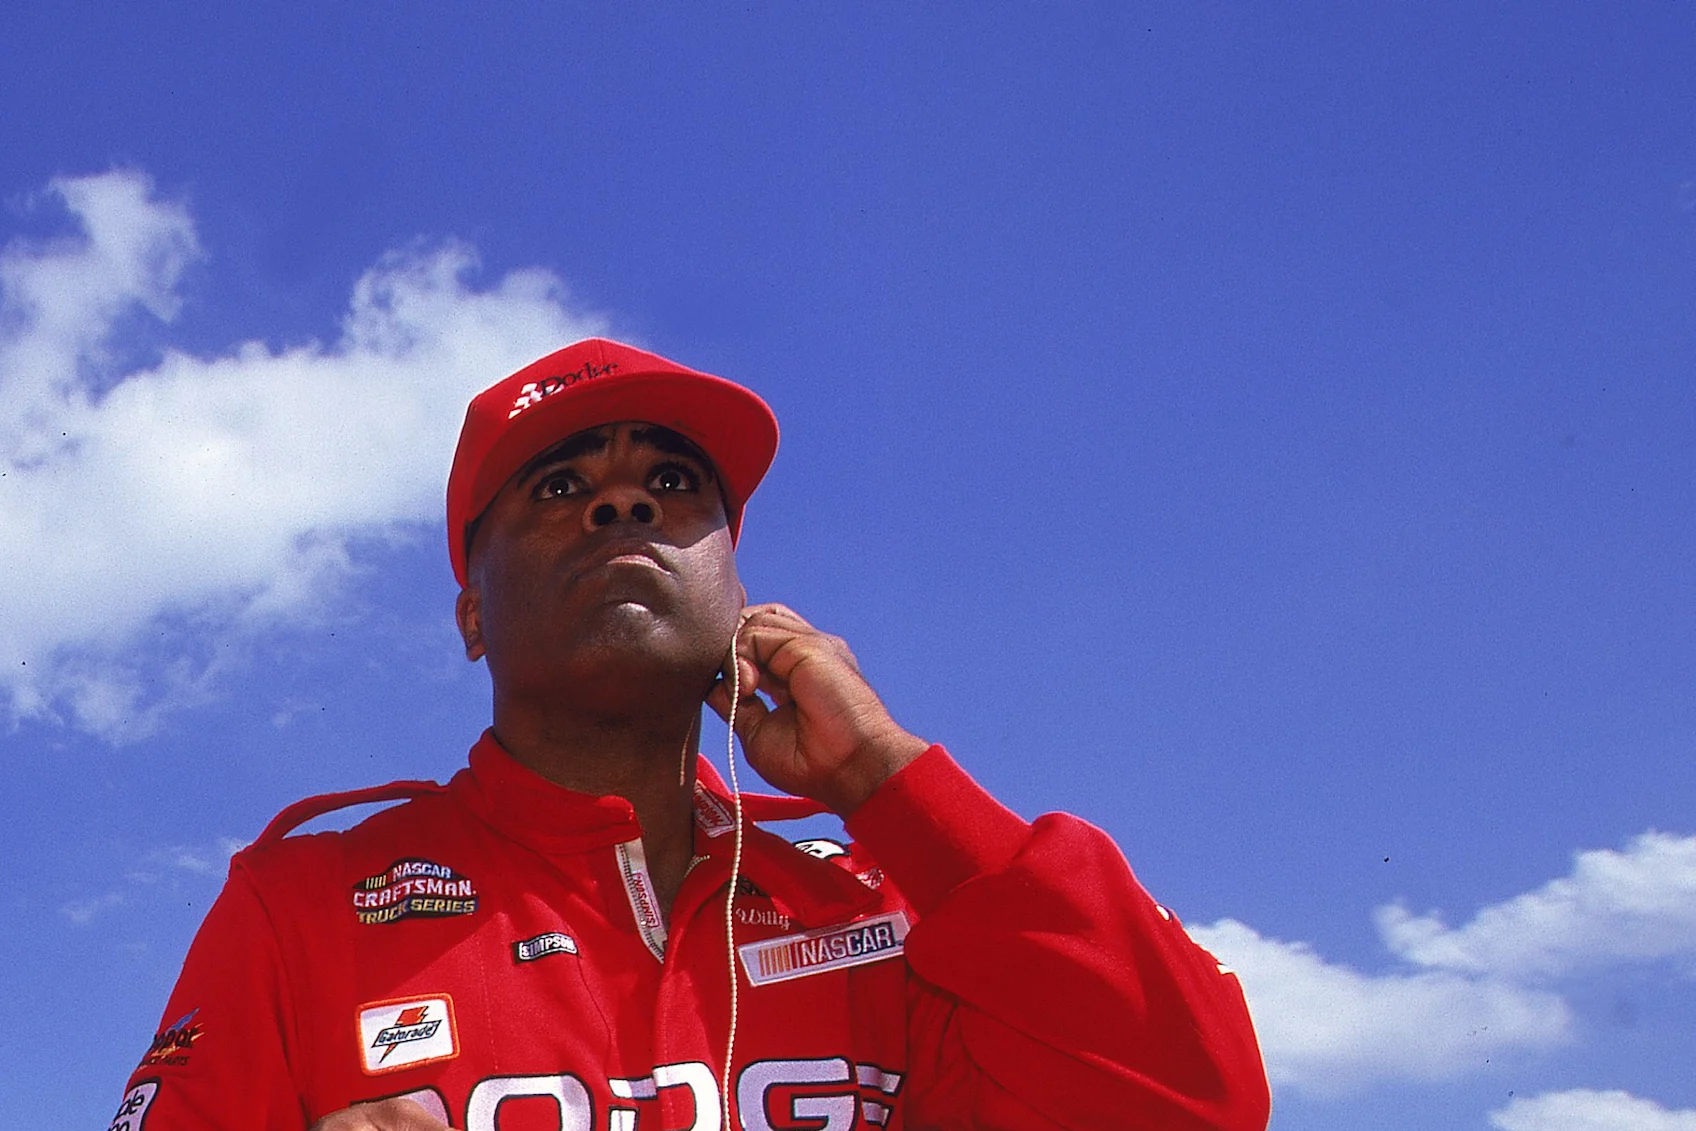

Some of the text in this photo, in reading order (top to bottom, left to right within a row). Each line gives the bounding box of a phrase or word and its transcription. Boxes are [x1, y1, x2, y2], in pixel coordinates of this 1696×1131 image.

[392, 861, 452, 882] NASCAR
[356, 899, 475, 925] TRUCK SERIES
[521, 935, 576, 957] SIMPSON
[799, 924, 894, 967] NASCAR
[378, 1024, 435, 1045] Gatorade
